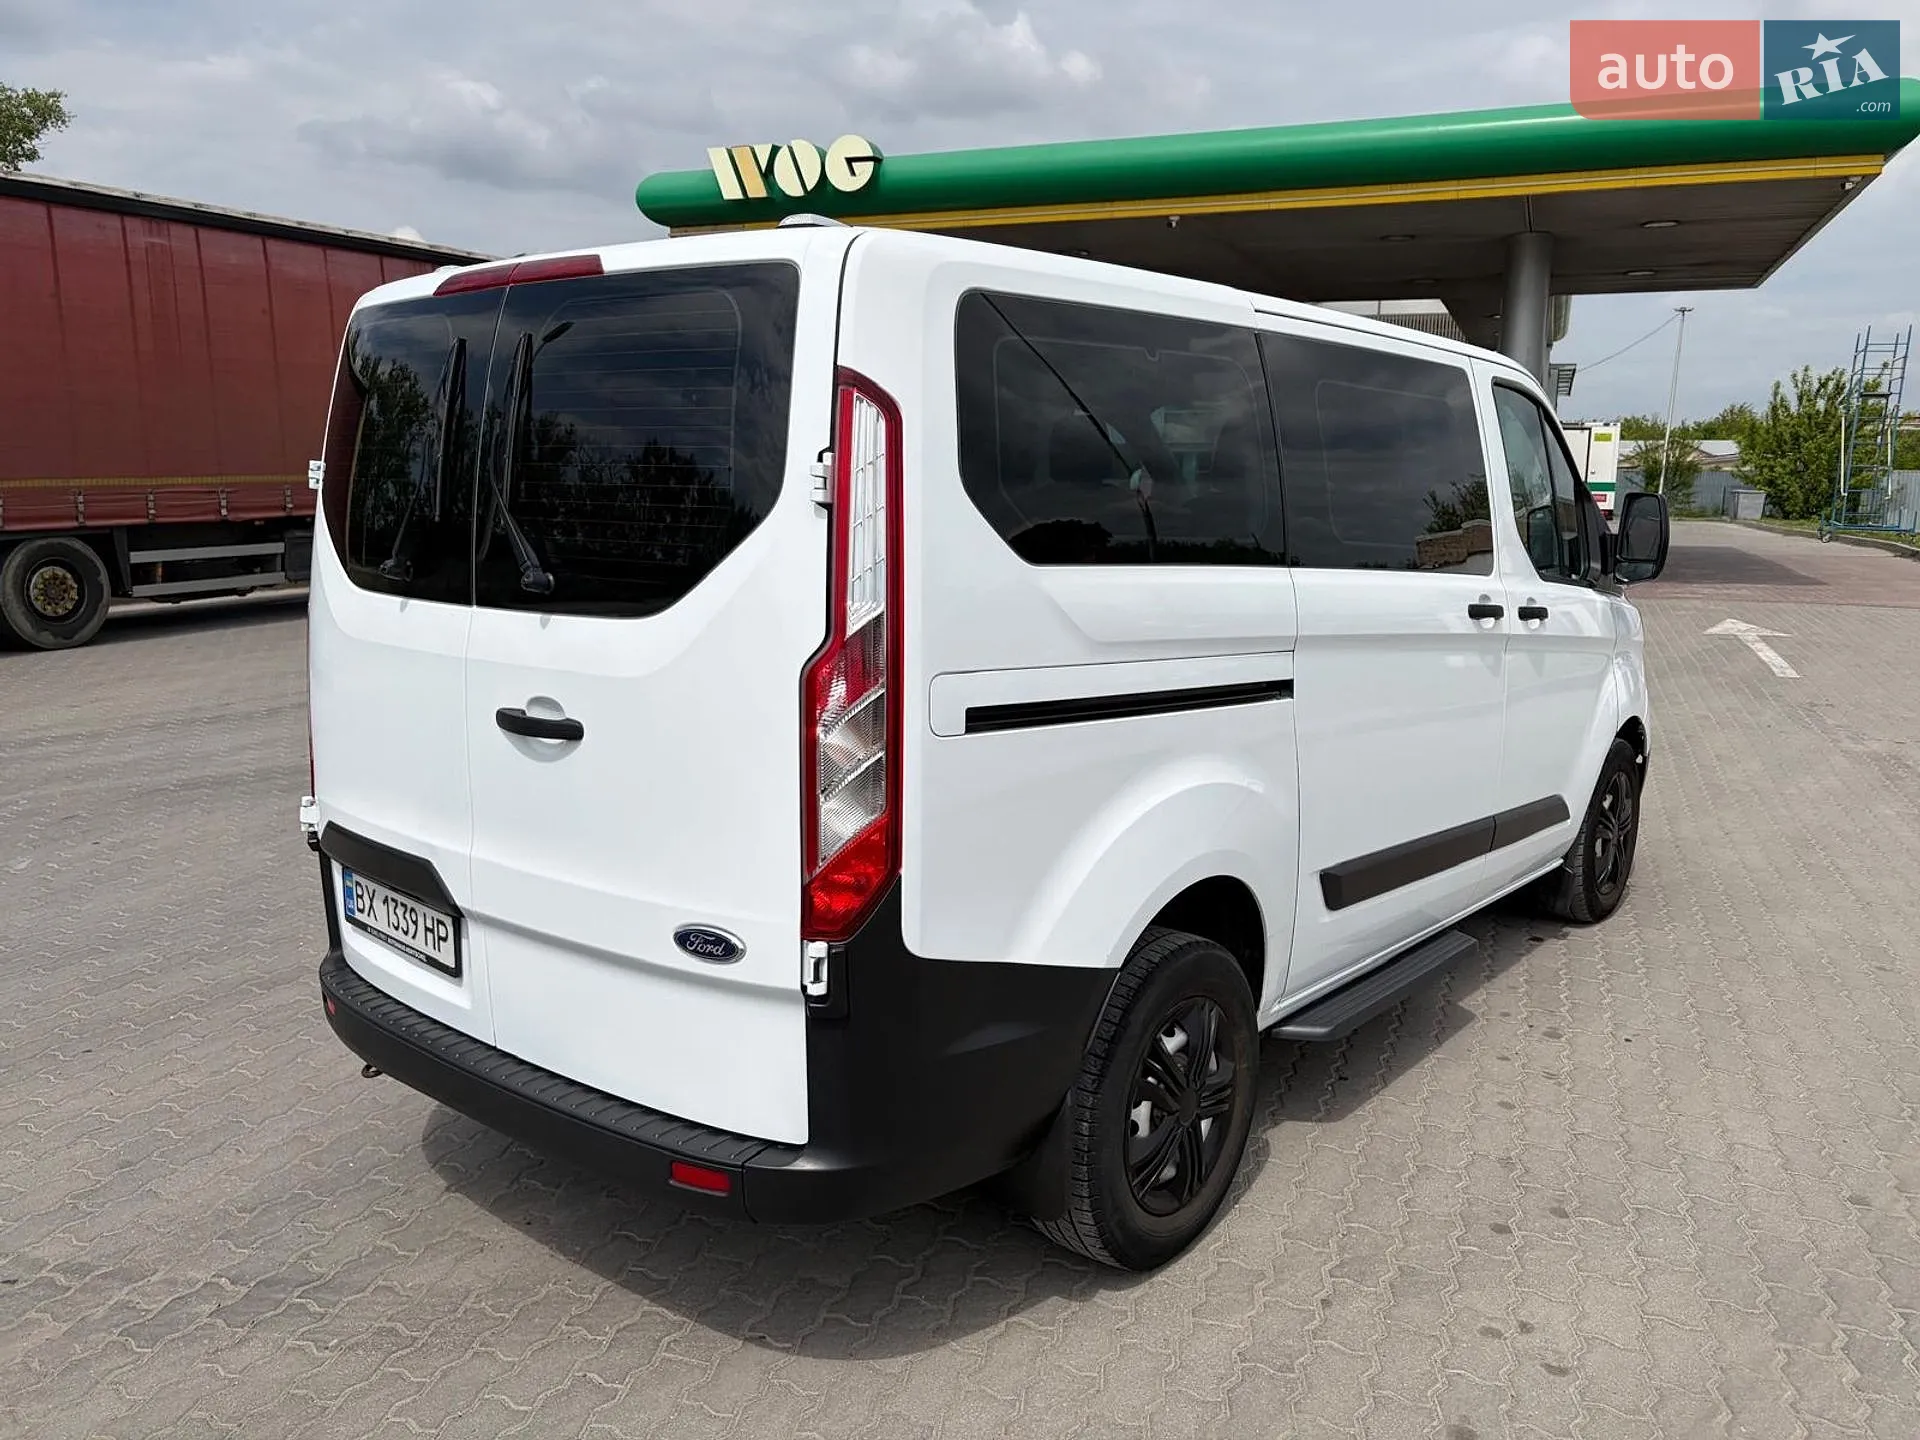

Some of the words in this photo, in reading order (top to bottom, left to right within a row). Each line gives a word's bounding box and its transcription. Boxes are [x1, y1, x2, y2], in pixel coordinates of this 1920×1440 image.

[707, 134, 878, 200] WOG
[355, 880, 378, 922] BX
[382, 894, 419, 940] 1339
[424, 912, 449, 952] HP
[686, 932, 726, 957] Ford
